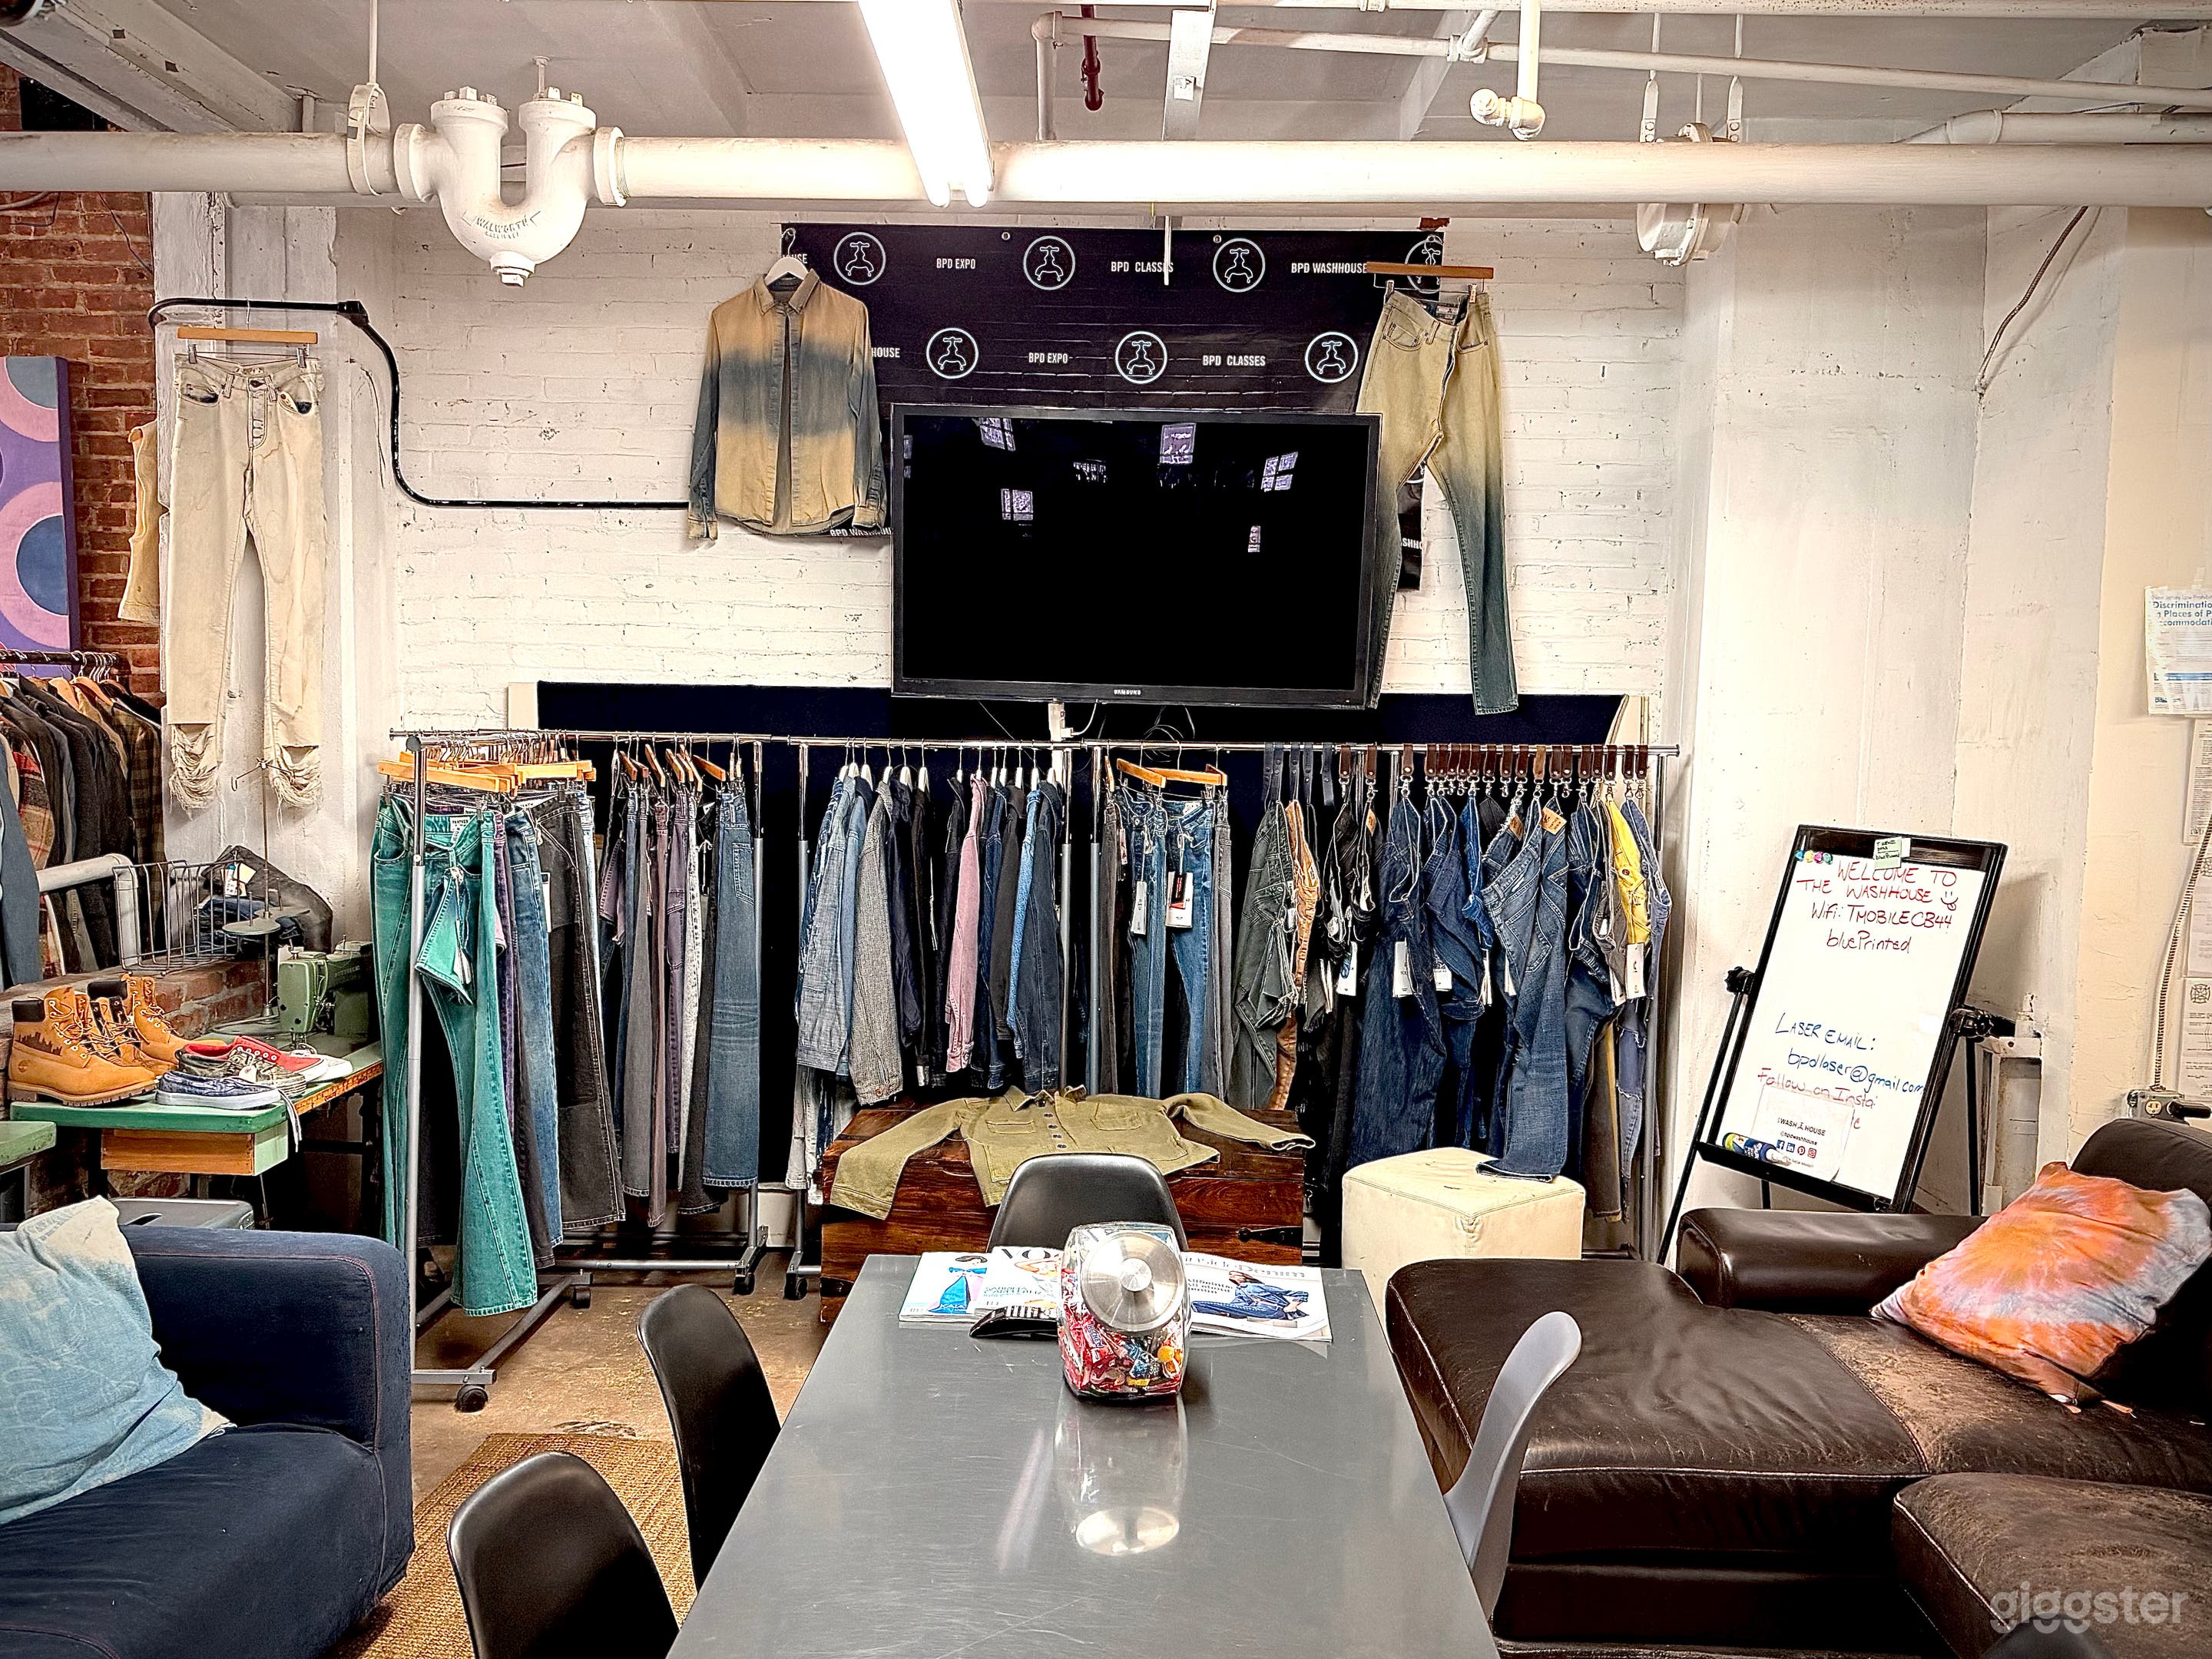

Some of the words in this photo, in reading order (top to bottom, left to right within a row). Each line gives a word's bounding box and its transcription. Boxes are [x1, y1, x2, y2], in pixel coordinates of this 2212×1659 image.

[936, 257, 953, 269] BPD
[955, 258, 976, 270] EXPO
[1111, 261, 1130, 272] BPD
[1134, 261, 1174, 273] CLASSS
[1291, 263, 1310, 273] BPD
[1312, 263, 1368, 274] WASHHOUSE
[1028, 352, 1045, 363] BPD
[1047, 353, 1068, 364] EXPO
[1203, 355, 1222, 366] BPD
[1227, 355, 1267, 366] CLASSES
[830, 528, 849, 537] BPD
[2194, 609, 2204, 618] of
[1837, 860, 1919, 883] WELCOME
[1930, 870, 1957, 887] TO
[1796, 879, 1833, 894] THE
[1846, 883, 1933, 903] WASHHOUSE
[1775, 1012, 1822, 1038] LASER
[1813, 1086, 1830, 1099] on
[1780, 1118, 1798, 1128] WASH
[1804, 1124, 1826, 1137] HOUSE
